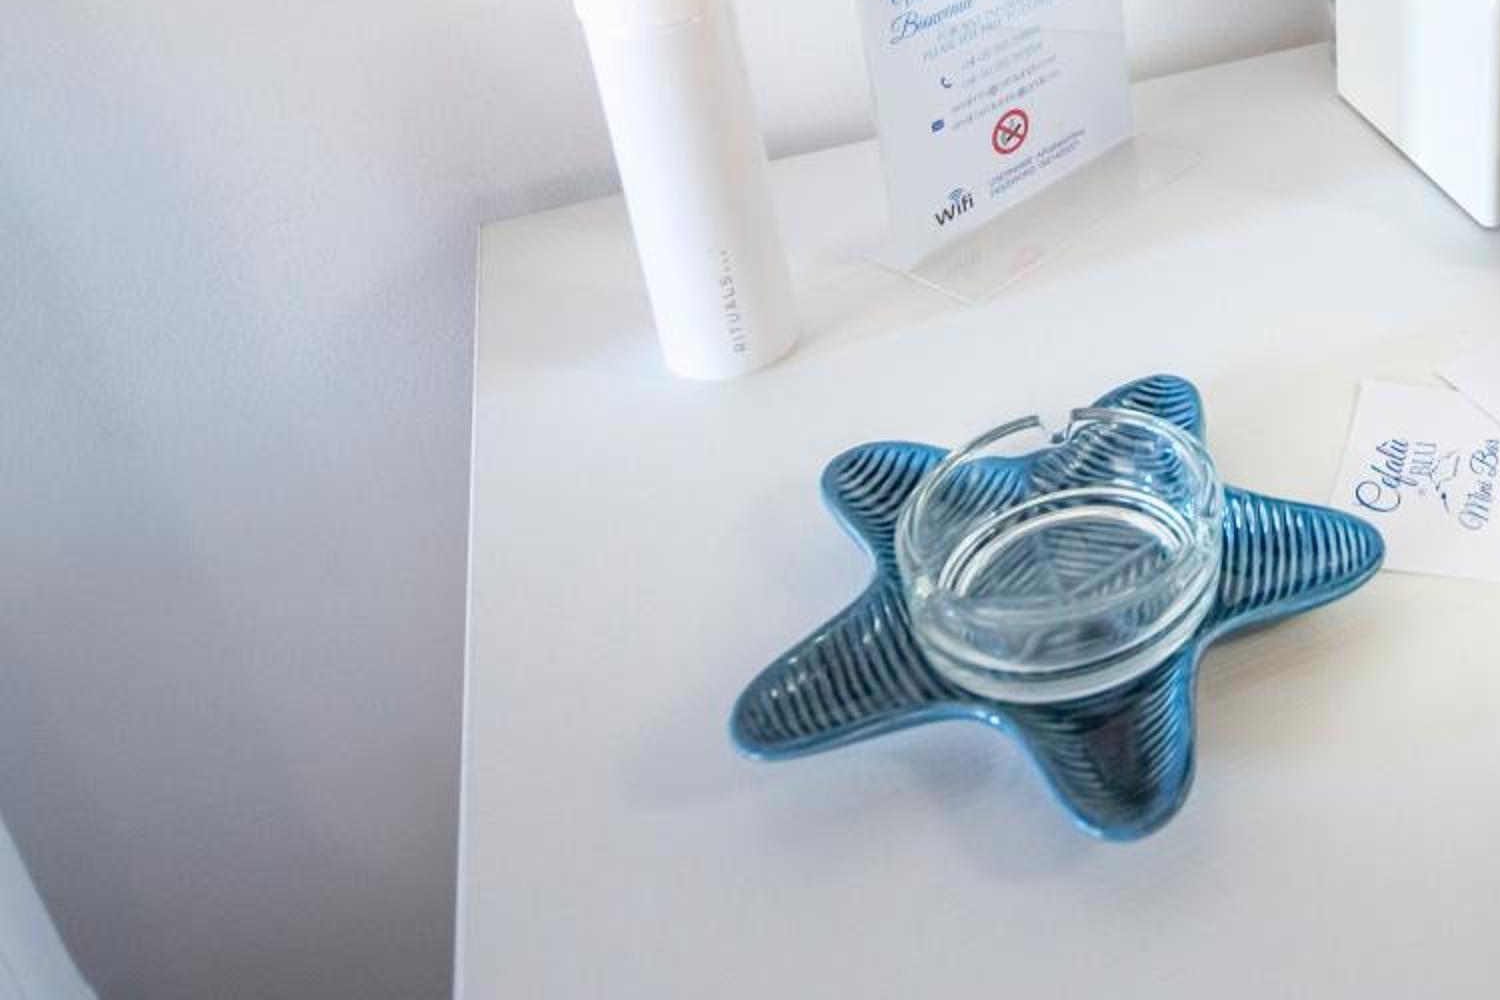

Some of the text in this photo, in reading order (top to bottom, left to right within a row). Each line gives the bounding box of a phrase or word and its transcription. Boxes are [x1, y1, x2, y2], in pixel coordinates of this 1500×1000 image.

[1355, 438, 1419, 512] Cefalù
[1409, 441, 1437, 475] BLU
[1458, 478, 1494, 531] Mini
